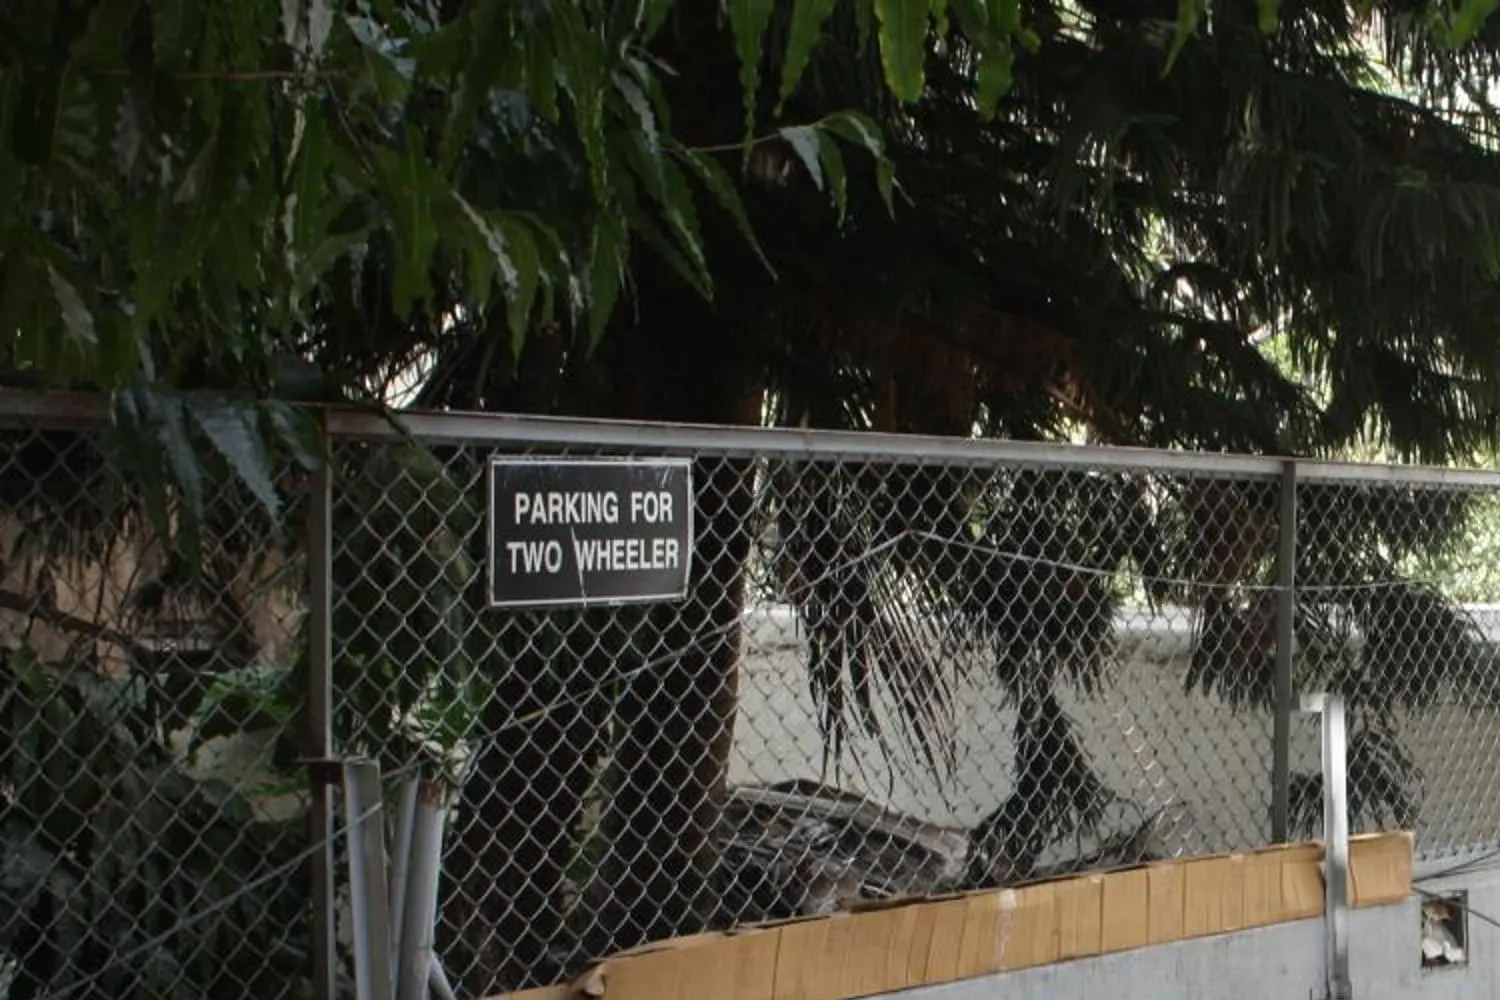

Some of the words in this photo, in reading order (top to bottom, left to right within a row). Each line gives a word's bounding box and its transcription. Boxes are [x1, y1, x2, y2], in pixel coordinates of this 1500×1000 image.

[515, 491, 619, 525] PARKING
[631, 491, 674, 524] FOR
[506, 540, 563, 575] TWO
[574, 538, 679, 572] WHEELER
